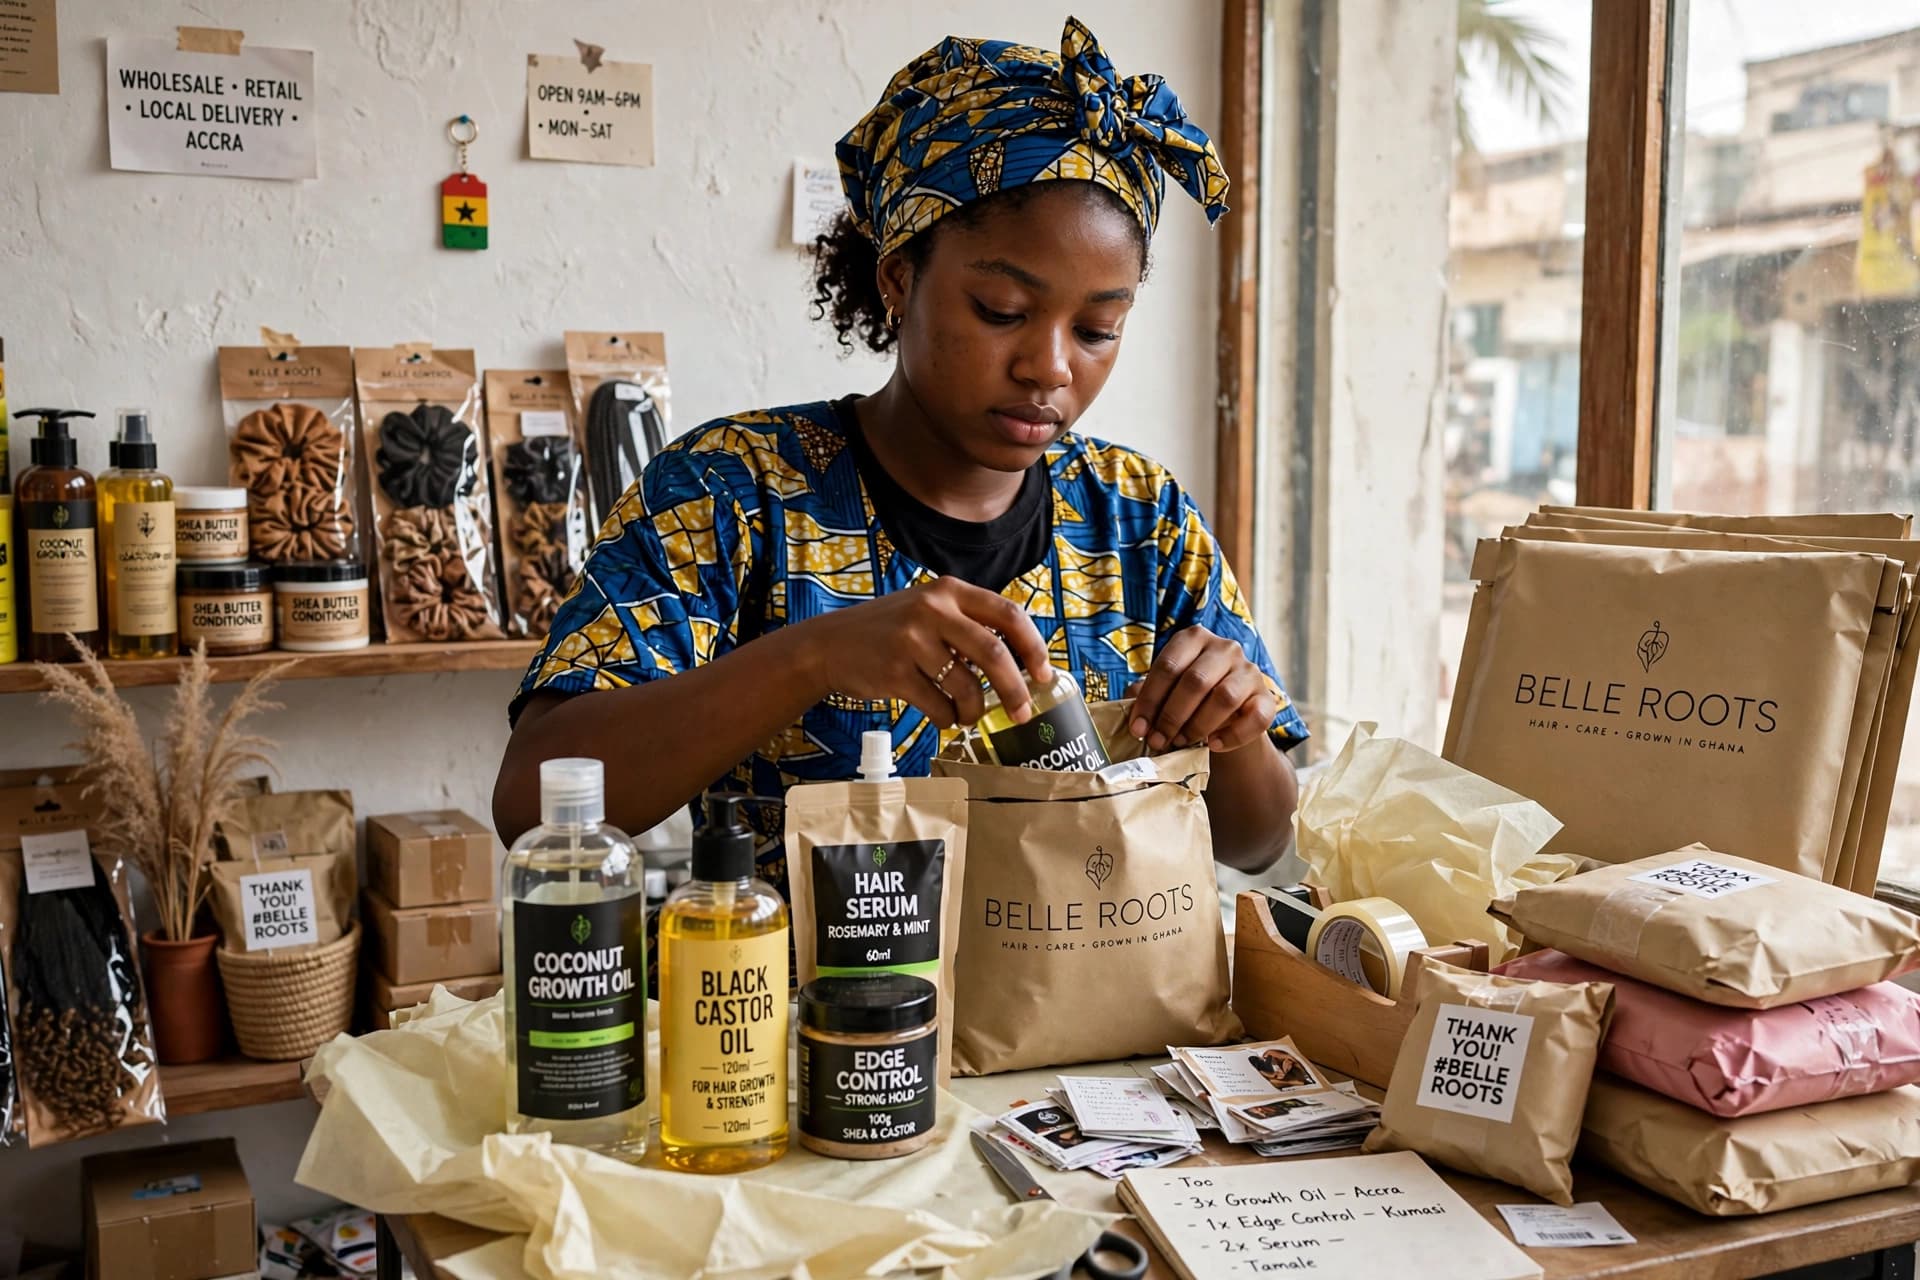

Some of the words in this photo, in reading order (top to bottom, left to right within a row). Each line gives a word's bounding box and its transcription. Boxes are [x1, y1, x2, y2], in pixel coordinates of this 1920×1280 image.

[119, 69, 225, 95] WHOLESALE
[245, 78, 303, 100] RETAIL
[538, 84, 573, 103] OPEN
[140, 99, 197, 121] LOCAL
[202, 103, 284, 126] DELIVERY
[186, 131, 244, 152] ACCRA
[177, 519, 202, 529] SHEA
[204, 518, 239, 530] BUTTER
[40, 539, 83, 549] COCONUT
[176, 530, 238, 542] CONDITIONER
[193, 602, 220, 615] SHEA
[224, 601, 262, 614] BUTTER
[292, 596, 319, 609] SHEA
[323, 596, 358, 608] BUTTER
[192, 614, 263, 627] CONDITIONER
[291, 609, 359, 622] CONDITIONER
[1515, 673, 1626, 715] BELLE
[1638, 687, 1779, 733] ROOTS
[1528, 719, 1558, 730] HAIR
[1576, 724, 1607, 736] CARE
[1626, 730, 1672, 744] GROWN
[1678, 737, 1692, 746] IN
[1698, 739, 1745, 754] GHANA
[1085, 750, 1105, 771] OIL
[249, 879, 304, 896] THANK
[855, 871, 905, 894] HAIR
[259, 894, 297, 909] YOU!
[846, 894, 919, 919] SERUM
[985, 898, 1083, 931] BELLE
[1099, 883, 1194, 928] ROOTS
[252, 906, 309, 924] #BELLE
[254, 921, 309, 939] ROOTS
[828, 923, 890, 939] ROSEMARY
[892, 922, 902, 936] &
[903, 919, 931, 935] MINT
[1001, 940, 1028, 951] HAIR
[1046, 942, 1075, 951] CARE
[1092, 936, 1132, 949] GROWN
[1137, 935, 1148, 944] IN
[1152, 926, 1183, 942] GHANA
[533, 945, 624, 974] COCONUT
[866, 948, 891, 961] 60ml
[528, 974, 608, 999] GROWTH
[611, 967, 636, 992] OIL
[701, 964, 768, 997] BLACK
[695, 993, 773, 1026] CASTOR
[720, 1027, 755, 1055] OIL
[1446, 1017, 1518, 1044] THANK
[854, 1048, 906, 1070] EDGE
[1452, 1037, 1502, 1061] YOU!
[722, 1060, 750, 1074] 120ml
[836, 1064, 923, 1091] CONTROL
[1434, 1057, 1511, 1086] #BELLE
[692, 1080, 711, 1094] FOR
[713, 1080, 737, 1094] HAIR
[739, 1072, 775, 1091] GROWTH
[1430, 1075, 1504, 1105] ROOTS
[706, 1097, 714, 1110] &
[716, 1092, 765, 1110] STRENGTH
[845, 1093, 887, 1105] STRONG
[888, 1088, 915, 1104] HOLD
[723, 1119, 751, 1133] 120ml
[868, 1113, 892, 1126] 100g
[843, 1127, 868, 1140] SHEA
[870, 1128, 878, 1139] &
[880, 1122, 916, 1138] CASTOR
[1189, 1196, 1218, 1209] 3x
[1225, 1191, 1292, 1207] Growth
[1300, 1188, 1327, 1202] Oil
[1354, 1186, 1405, 1198] Accra
[1206, 1218, 1231, 1231] 1x
[1237, 1215, 1285, 1231] Edge
[1291, 1208, 1356, 1225] Control
[1381, 1203, 1446, 1218] Kumasi
[1219, 1239, 1249, 1252] 2x
[1258, 1236, 1320, 1250] Serum
[1243, 1256, 1317, 1273] Tamale
